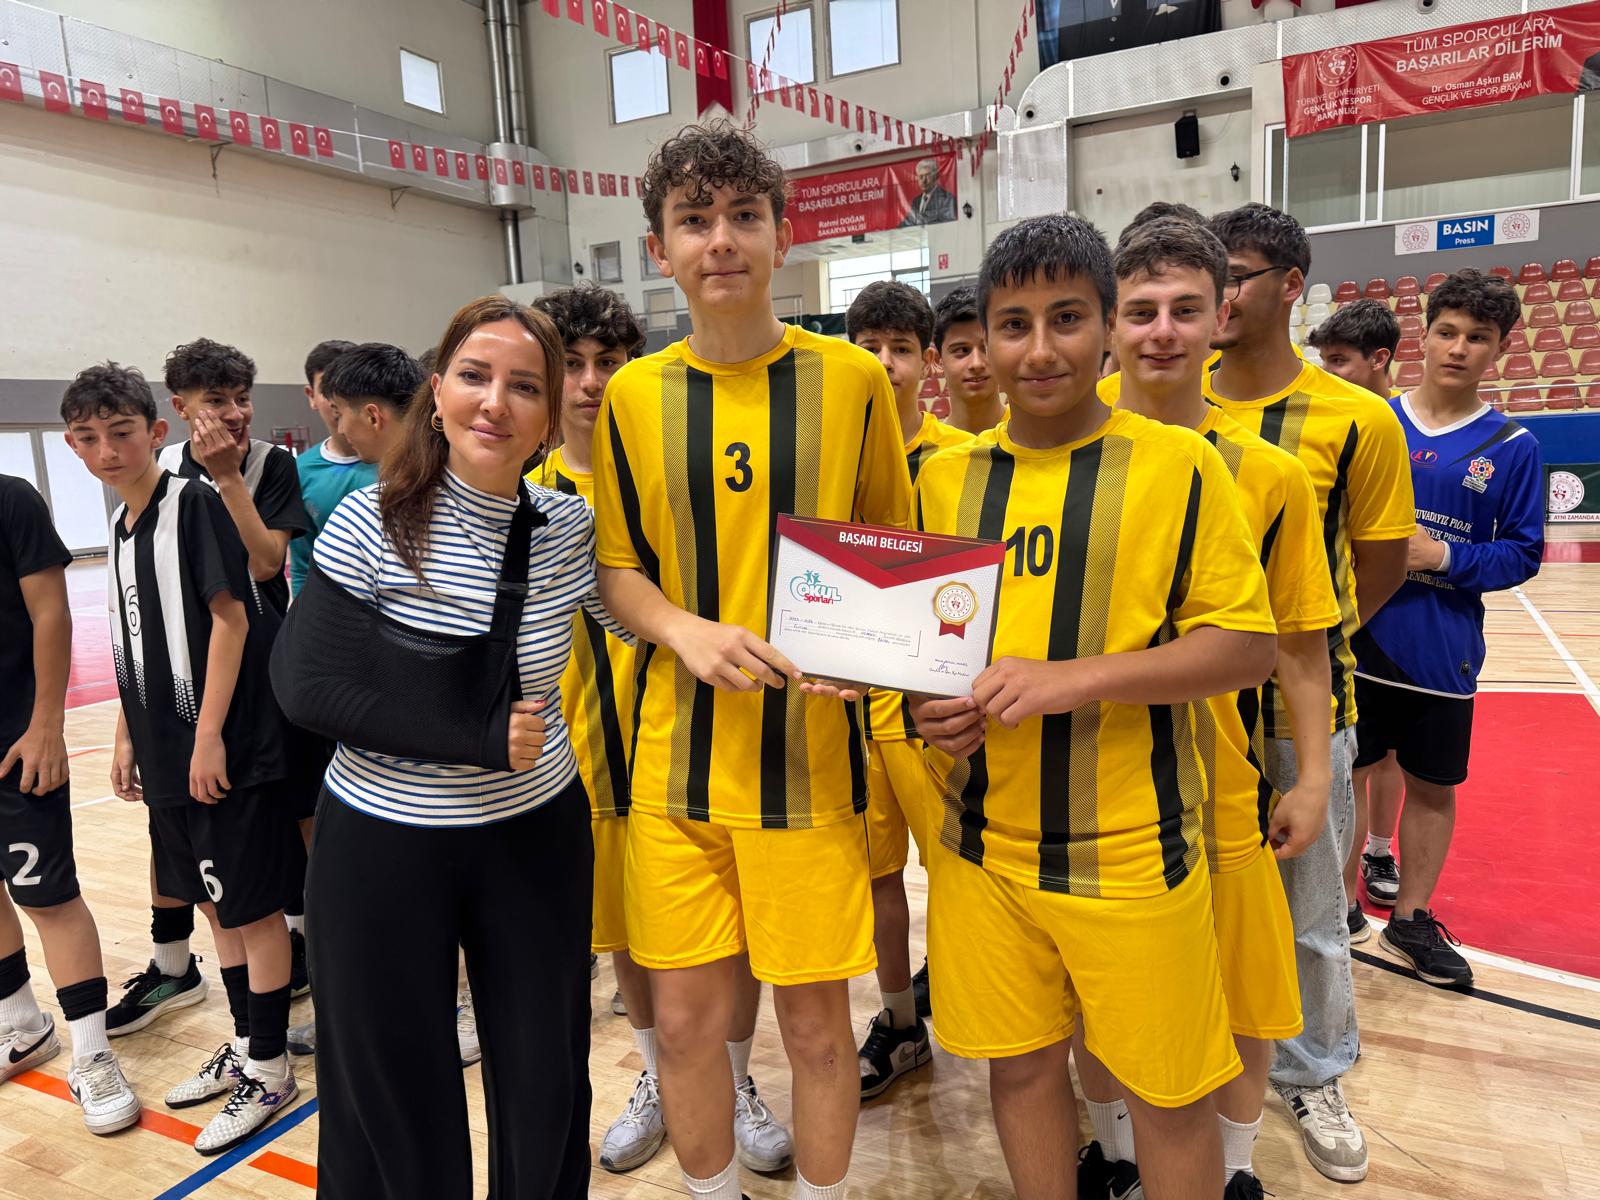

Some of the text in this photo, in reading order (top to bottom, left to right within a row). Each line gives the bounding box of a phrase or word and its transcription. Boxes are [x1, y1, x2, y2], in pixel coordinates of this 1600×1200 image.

[1403, 16, 1556, 54] TÜM SPORCULARA
[1396, 33, 1563, 73] BAŞARILAR DİLERİM
[1422, 80, 1532, 105] GENÇLİK VE SPOR BAKANI
[1445, 80, 1475, 92] Osman
[1503, 71, 1522, 82] BAK
[1340, 97, 1350, 106] VE
[1351, 96, 1372, 104] SPOR
[798, 188, 884, 212] BAŞARILAR DİLERİM
[802, 177, 880, 199] TÜM SPORCULARA
[1443, 219, 1489, 236] BASIN
[1455, 237, 1476, 246] Press
[724, 441, 754, 493] 3
[839, 531, 923, 553] BAŞARI BELGESİ
[1005, 524, 1054, 577] 10
[125, 584, 142, 637] 6
[8, 842, 42, 887] 2
[199, 859, 224, 903] 6
